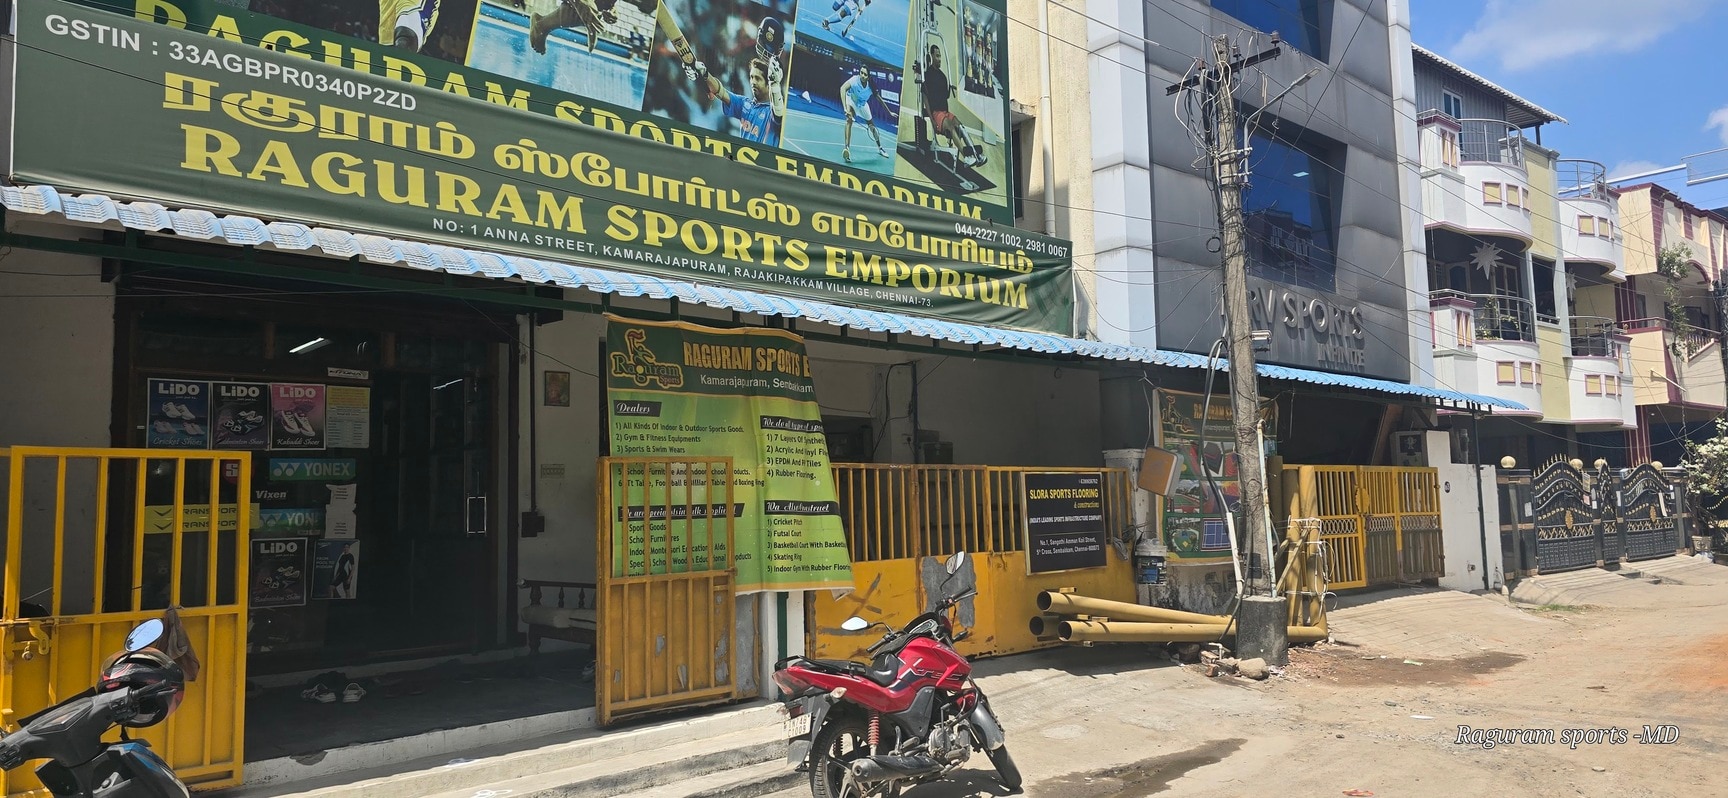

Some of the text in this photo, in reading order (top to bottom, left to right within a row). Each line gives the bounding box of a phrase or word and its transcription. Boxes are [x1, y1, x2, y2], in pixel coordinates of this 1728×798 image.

[45, 14, 417, 112] GSTIN : 33AGBPR0340P2ZD
[162, 71, 476, 160] ரகுராம்
[493, 138, 800, 227] ஸ்போர்ட்ஸ்
[180, 123, 1029, 310] RAGURAM SPORTS EMPORIUM
[955, 222, 1068, 258] 044-2227 1002, 2981 0067
[433, 218, 934, 308] NO: 1 ANNA STREET, KAMARAJAPURAM, RAJAKIPAKKAM VILLAGE, CHENNAI-73.
[1283, 291, 1364, 340] SPORTS
[683, 341, 752, 371] RAGURAM
[755, 347, 801, 377] SPORTS
[614, 355, 679, 382] Raguram
[616, 402, 650, 413] Dealers
[634, 422, 651, 430] Kinds
[685, 424, 707, 432] Outdoor
[709, 425, 726, 433] Sports
[623, 434, 638, 443] Gym
[668, 434, 701, 443] Equipments
[625, 445, 644, 454] Sports
[303, 462, 351, 477] YONEX
[255, 490, 287, 500] Vixen
[1029, 488, 1099, 499] SLORA SPORTS FLOORING
[773, 518, 793, 526] Cricket
[773, 565, 792, 573] Indoor
[810, 564, 832, 572] Rubber
